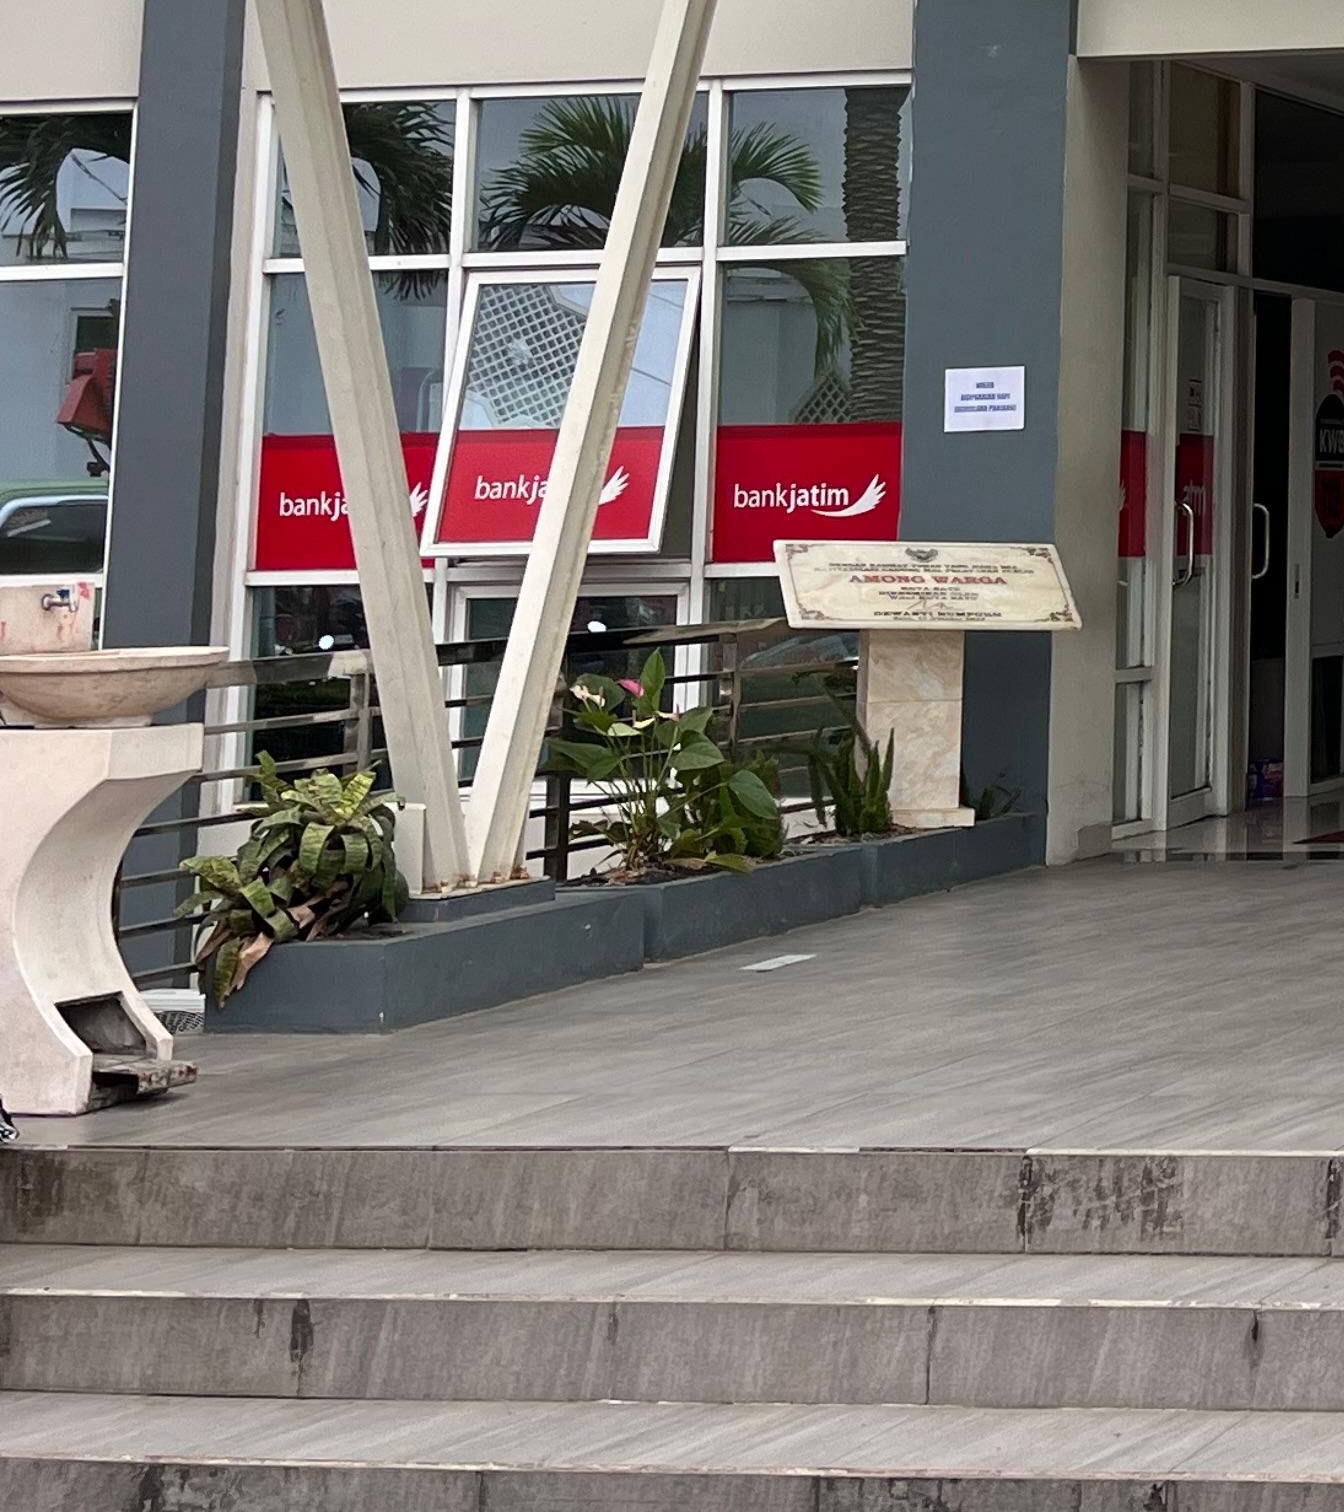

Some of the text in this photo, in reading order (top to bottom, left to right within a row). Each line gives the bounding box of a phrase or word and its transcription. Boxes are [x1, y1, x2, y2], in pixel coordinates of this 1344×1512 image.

[474, 474, 549, 503] bankja
[733, 482, 850, 514] bankjatim
[278, 490, 351, 522] bankja
[849, 575, 1008, 585] AMONG WARGA
